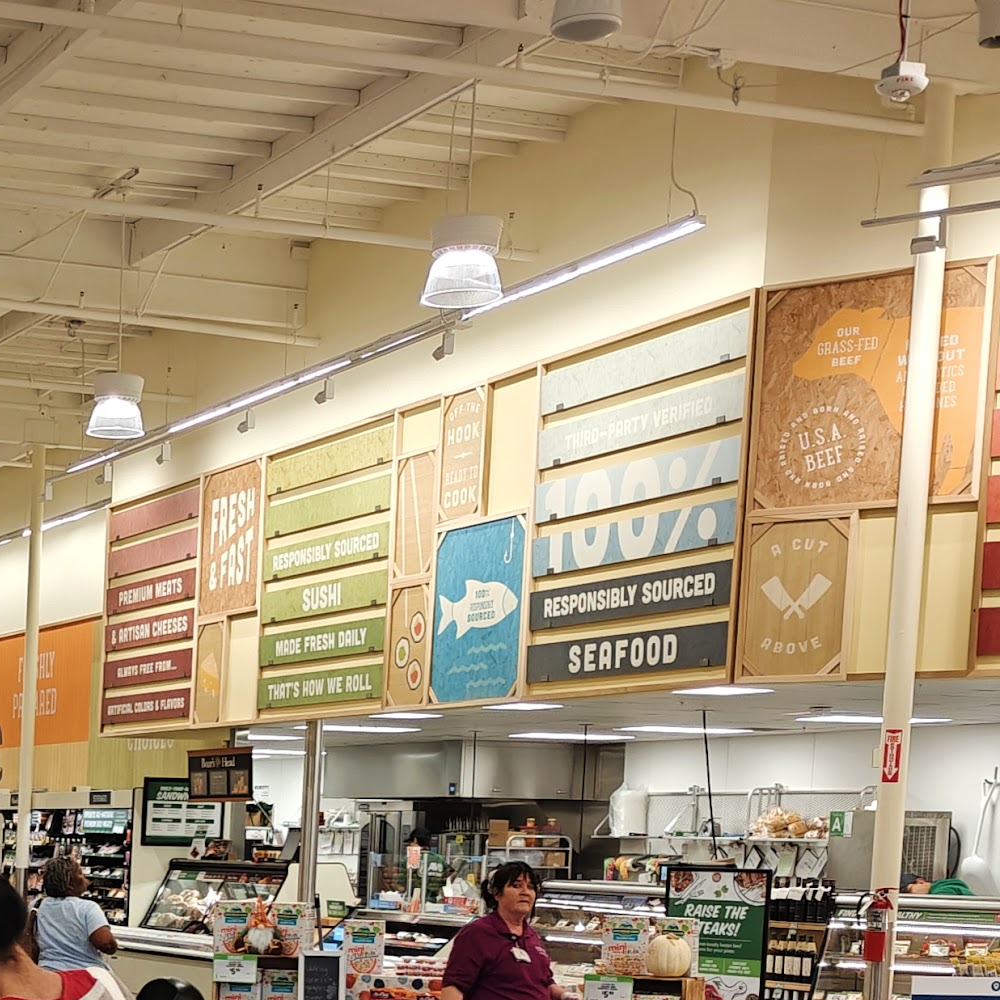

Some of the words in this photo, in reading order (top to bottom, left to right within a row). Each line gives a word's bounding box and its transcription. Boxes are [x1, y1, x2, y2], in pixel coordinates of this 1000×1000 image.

[836, 326, 860, 338] OUR
[816, 336, 879, 356] GRASS-FED
[831, 355, 862, 367] BEEF
[449, 403, 464, 422] OFF
[466, 402, 481, 414] THE
[564, 411, 650, 450] THIRD-PARTY
[652, 395, 713, 429] VERIFIED
[447, 421, 481, 446] HOOK
[798, 423, 847, 450] U.S.A.
[804, 445, 843, 472] BEEF
[445, 467, 468, 485] READY
[469, 465, 479, 479] TO
[444, 485, 477, 509] COOK
[543, 437, 719, 574] 100%
[210, 486, 256, 555] FRESH
[272, 542, 332, 571] RESPONSIBLY
[334, 532, 379, 558] SOURCED
[770, 543, 783, 557] A
[792, 537, 829, 554] CUT
[208, 563, 218, 591] &
[220, 535, 254, 590] FAST
[118, 587, 153, 607] PREMIUM
[155, 577, 182, 598] MEATS
[302, 582, 342, 612] SUSHI
[543, 581, 637, 619] RESPONSIBLY
[641, 572, 716, 601] SOURCED
[467, 610, 496, 623] SOURCED
[118, 623, 150, 643] ARTISAN
[152, 615, 188, 637] CHEESES
[275, 636, 302, 657] MADE
[304, 632, 335, 653] FRESH
[338, 627, 367, 648] DAILY
[567, 633, 678, 674] SEAFOOD
[760, 635, 823, 655] ABOVE
[117, 664, 138, 678] ALWAYS
[139, 662, 154, 675] FREE
[268, 681, 300, 701] THAT'S
[302, 678, 324, 697] HOW
[327, 676, 343, 695] WE
[345, 673, 372, 693] ROLL
[134, 700, 154, 713] COLORS
[160, 697, 185, 711] FLAVORS
[886, 735, 900, 743] FIRE
[221, 756, 236, 768] Head
[832, 818, 841, 832] A
[684, 903, 722, 919] RAISE
[724, 905, 749, 920] THE
